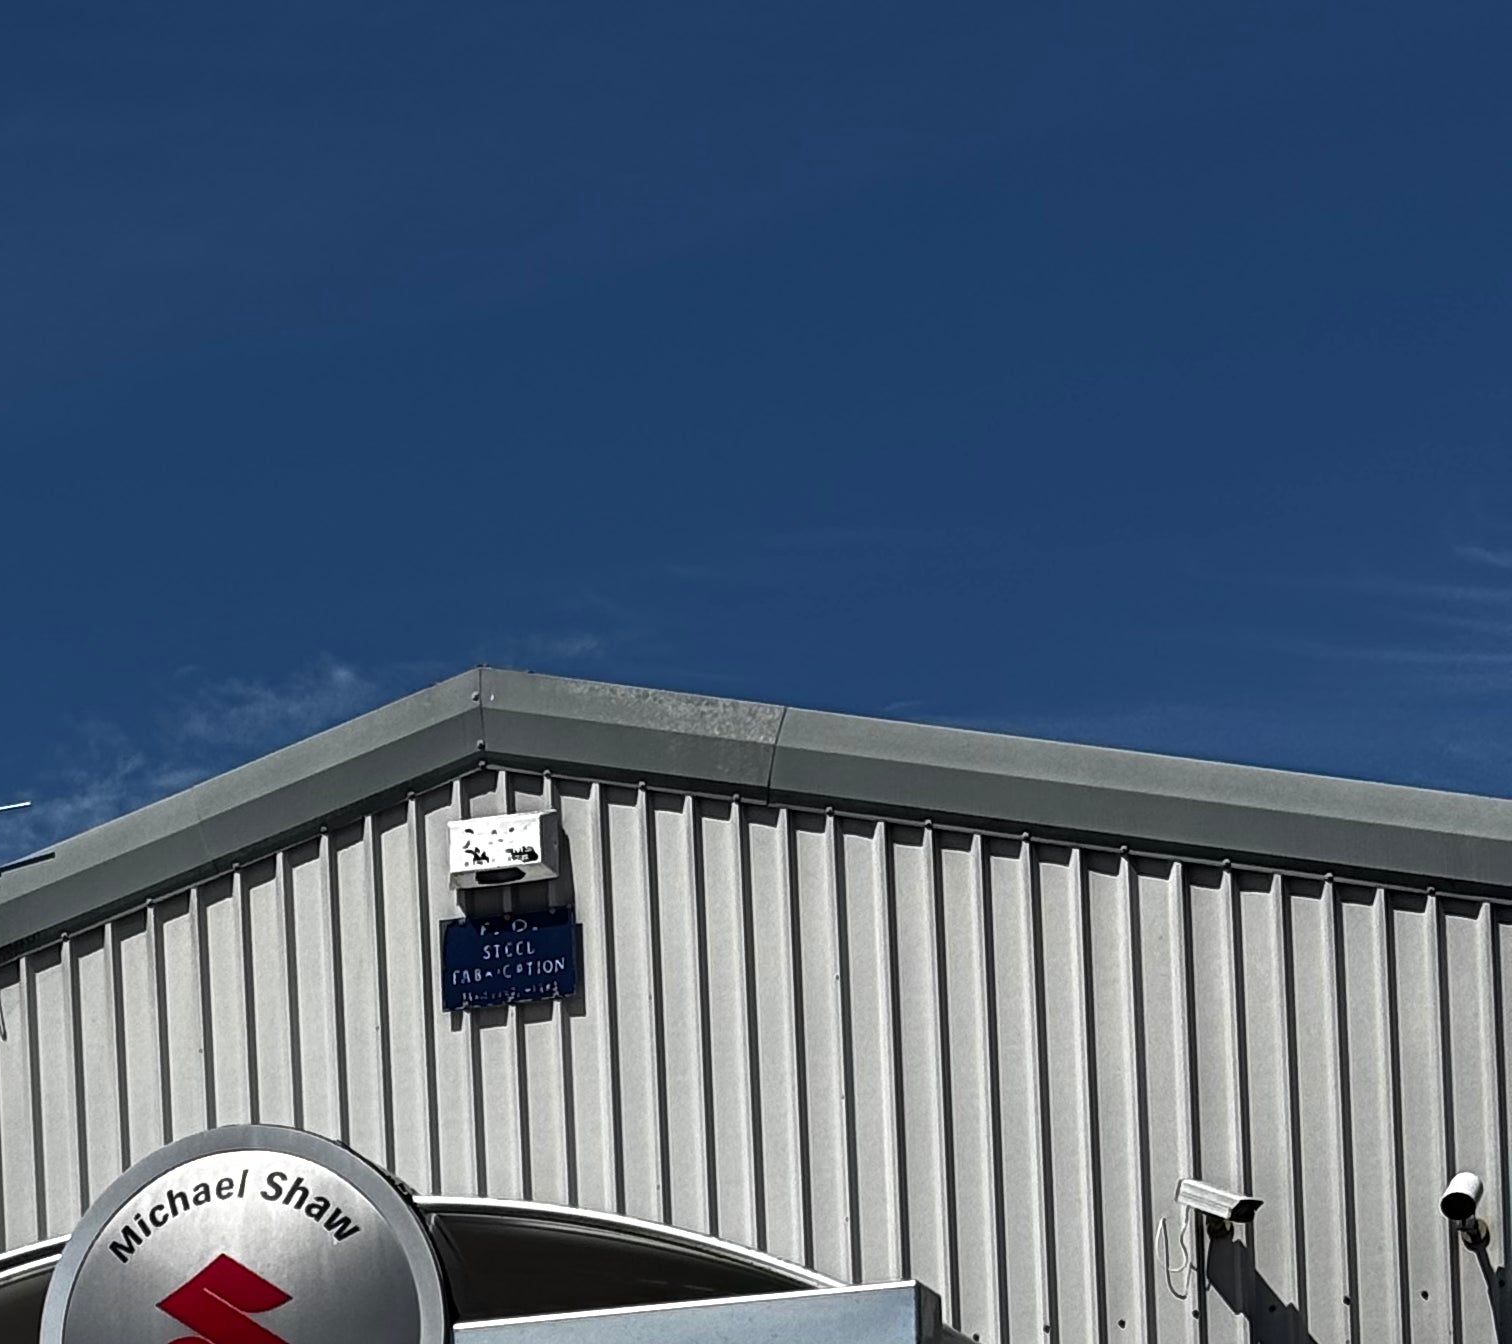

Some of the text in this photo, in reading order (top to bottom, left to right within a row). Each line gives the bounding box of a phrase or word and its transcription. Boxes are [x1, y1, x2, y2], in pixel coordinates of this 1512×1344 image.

[482, 940, 536, 960] STEEL
[452, 957, 565, 986] FABICATION
[107, 1169, 363, 1264] Michael Shaw
